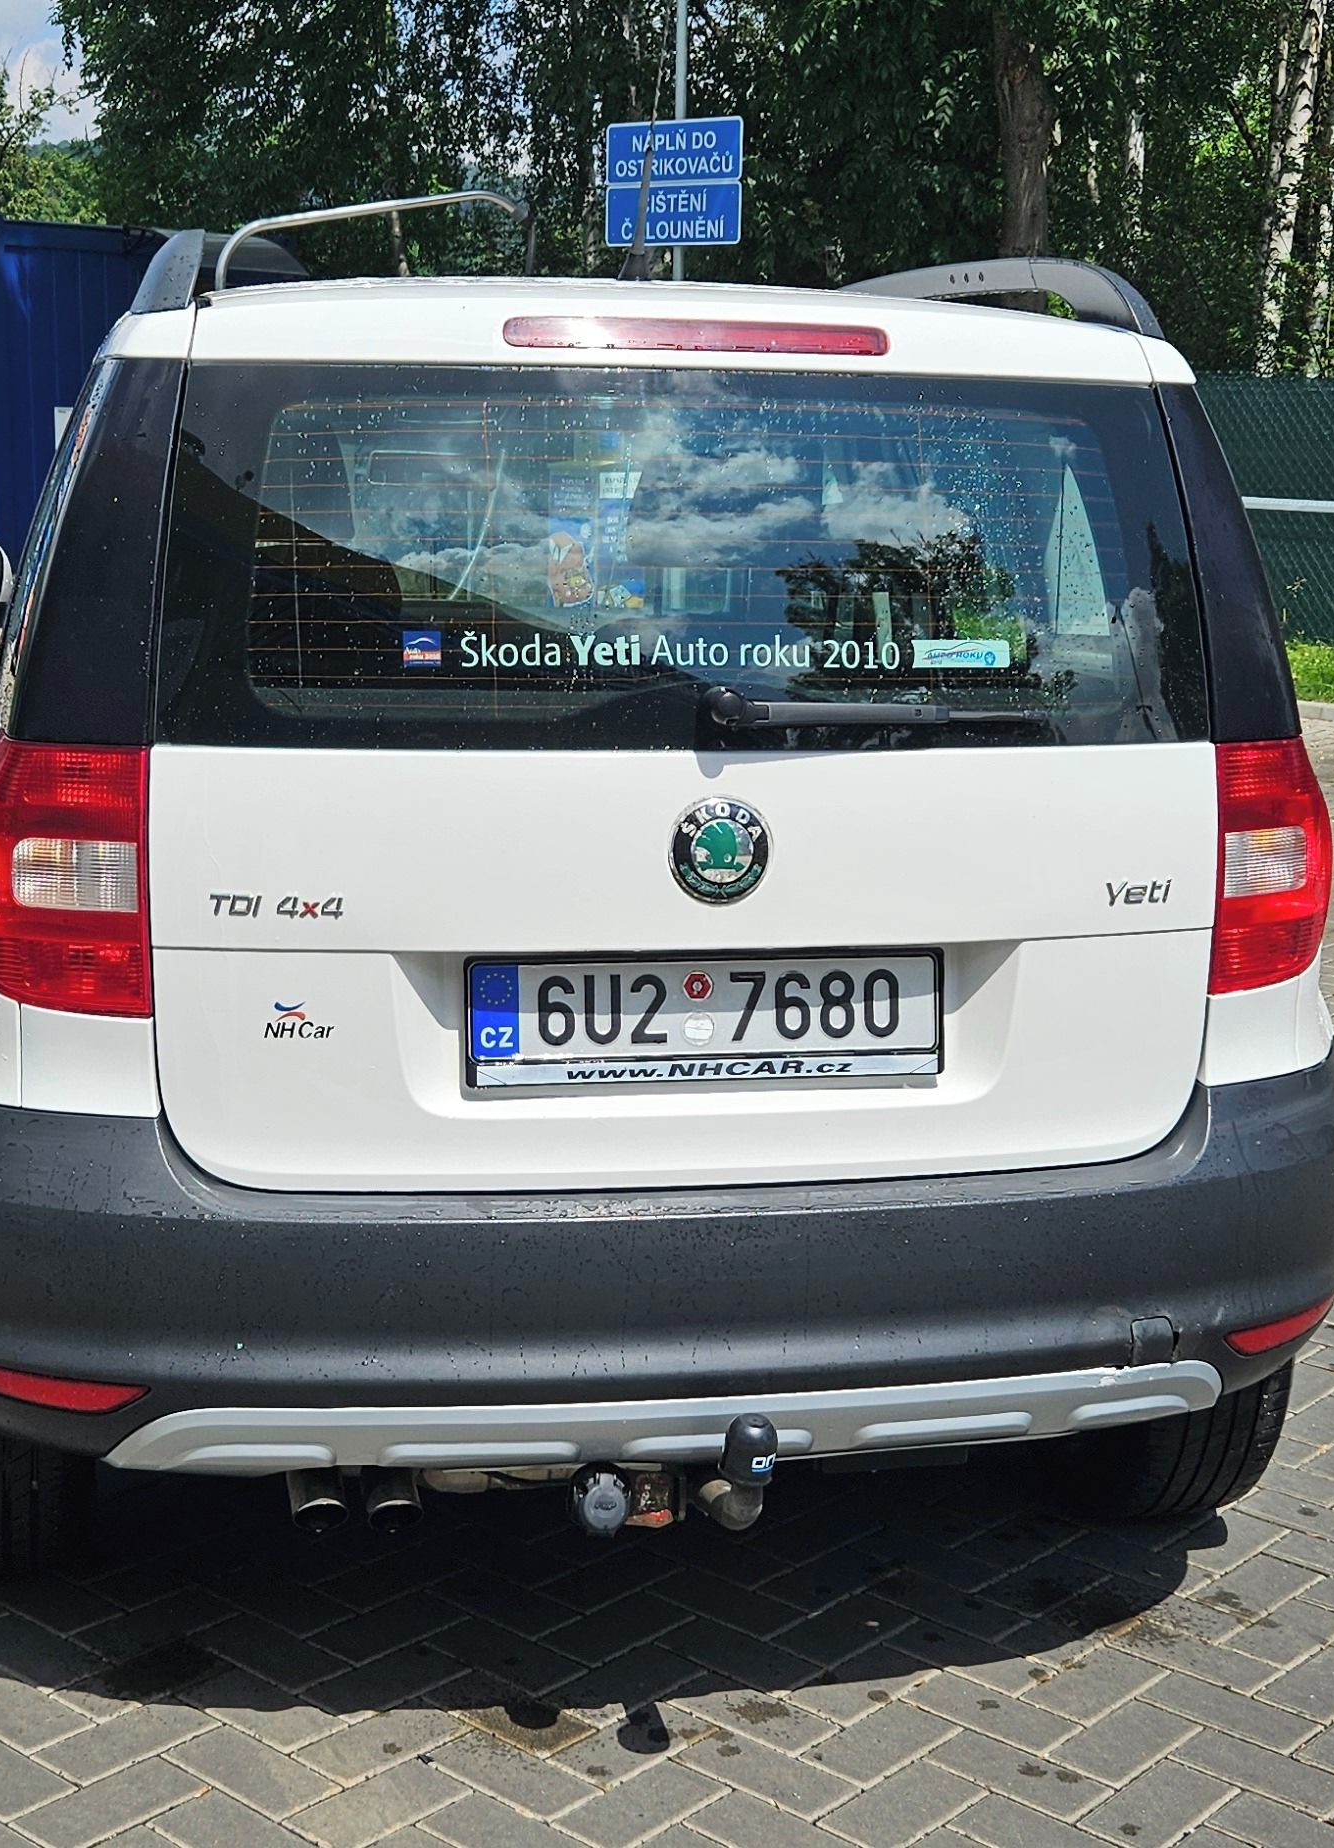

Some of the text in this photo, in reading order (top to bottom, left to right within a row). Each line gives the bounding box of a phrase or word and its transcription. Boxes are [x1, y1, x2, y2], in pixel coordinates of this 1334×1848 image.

[632, 128, 717, 153] NÁPLŇ DO
[646, 188, 707, 213] IŠTĚNÍ
[621, 215, 724, 240] ČLOUNĚNÍ
[460, 631, 901, 670] Škoda Yeti Auto roku 2010
[1106, 878, 1173, 907] Yeti
[209, 893, 344, 920] TDI 4x4
[537, 969, 899, 1046] 6U2 7680
[480, 1026, 514, 1049] CZ
[567, 1060, 853, 1080] www.NHCAR.cz
